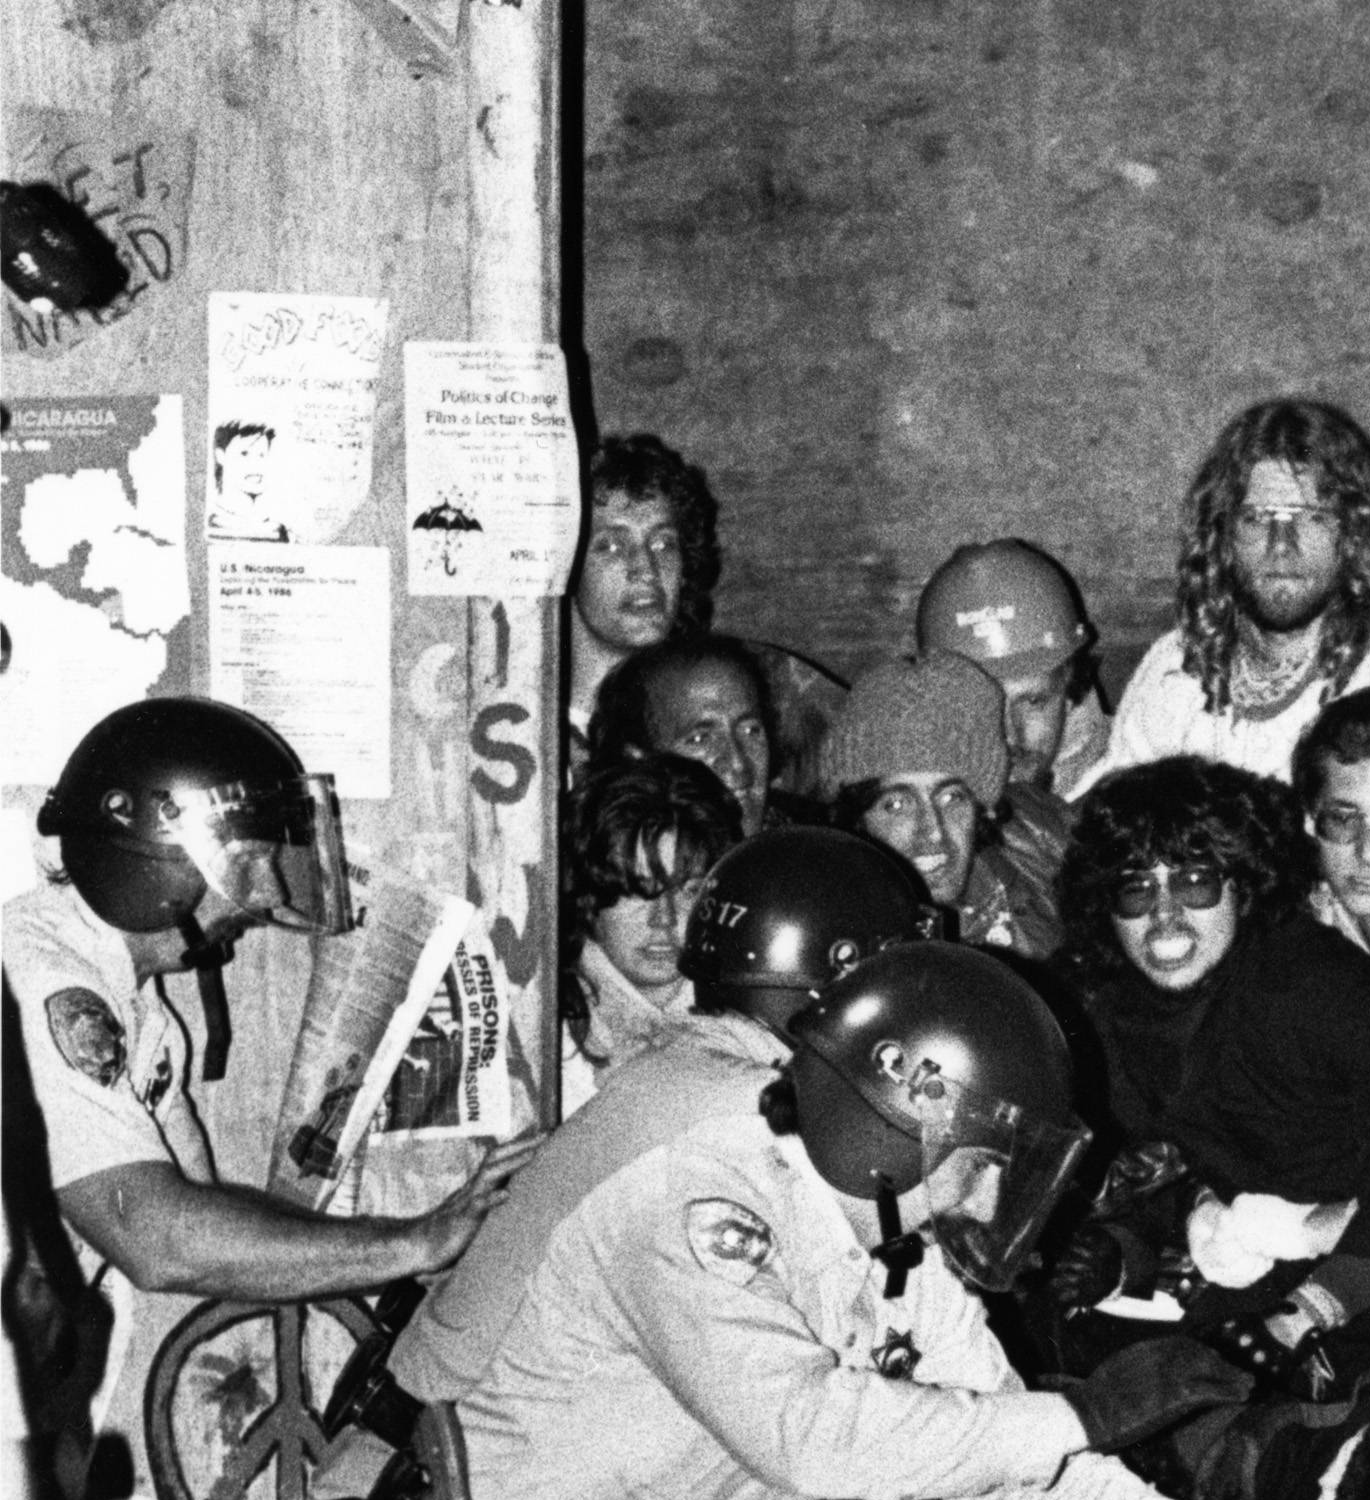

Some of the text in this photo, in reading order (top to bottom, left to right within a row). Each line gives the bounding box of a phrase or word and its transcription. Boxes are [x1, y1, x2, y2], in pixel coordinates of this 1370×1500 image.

[441, 388, 559, 409] Politics of Change
[425, 409, 567, 427] Film & Lecture Series
[219, 586, 243, 597] April
[467, 1001, 482, 1020] OF
[470, 952, 500, 1070] PRISONS:
[464, 1025, 482, 1123] REPRESSION
